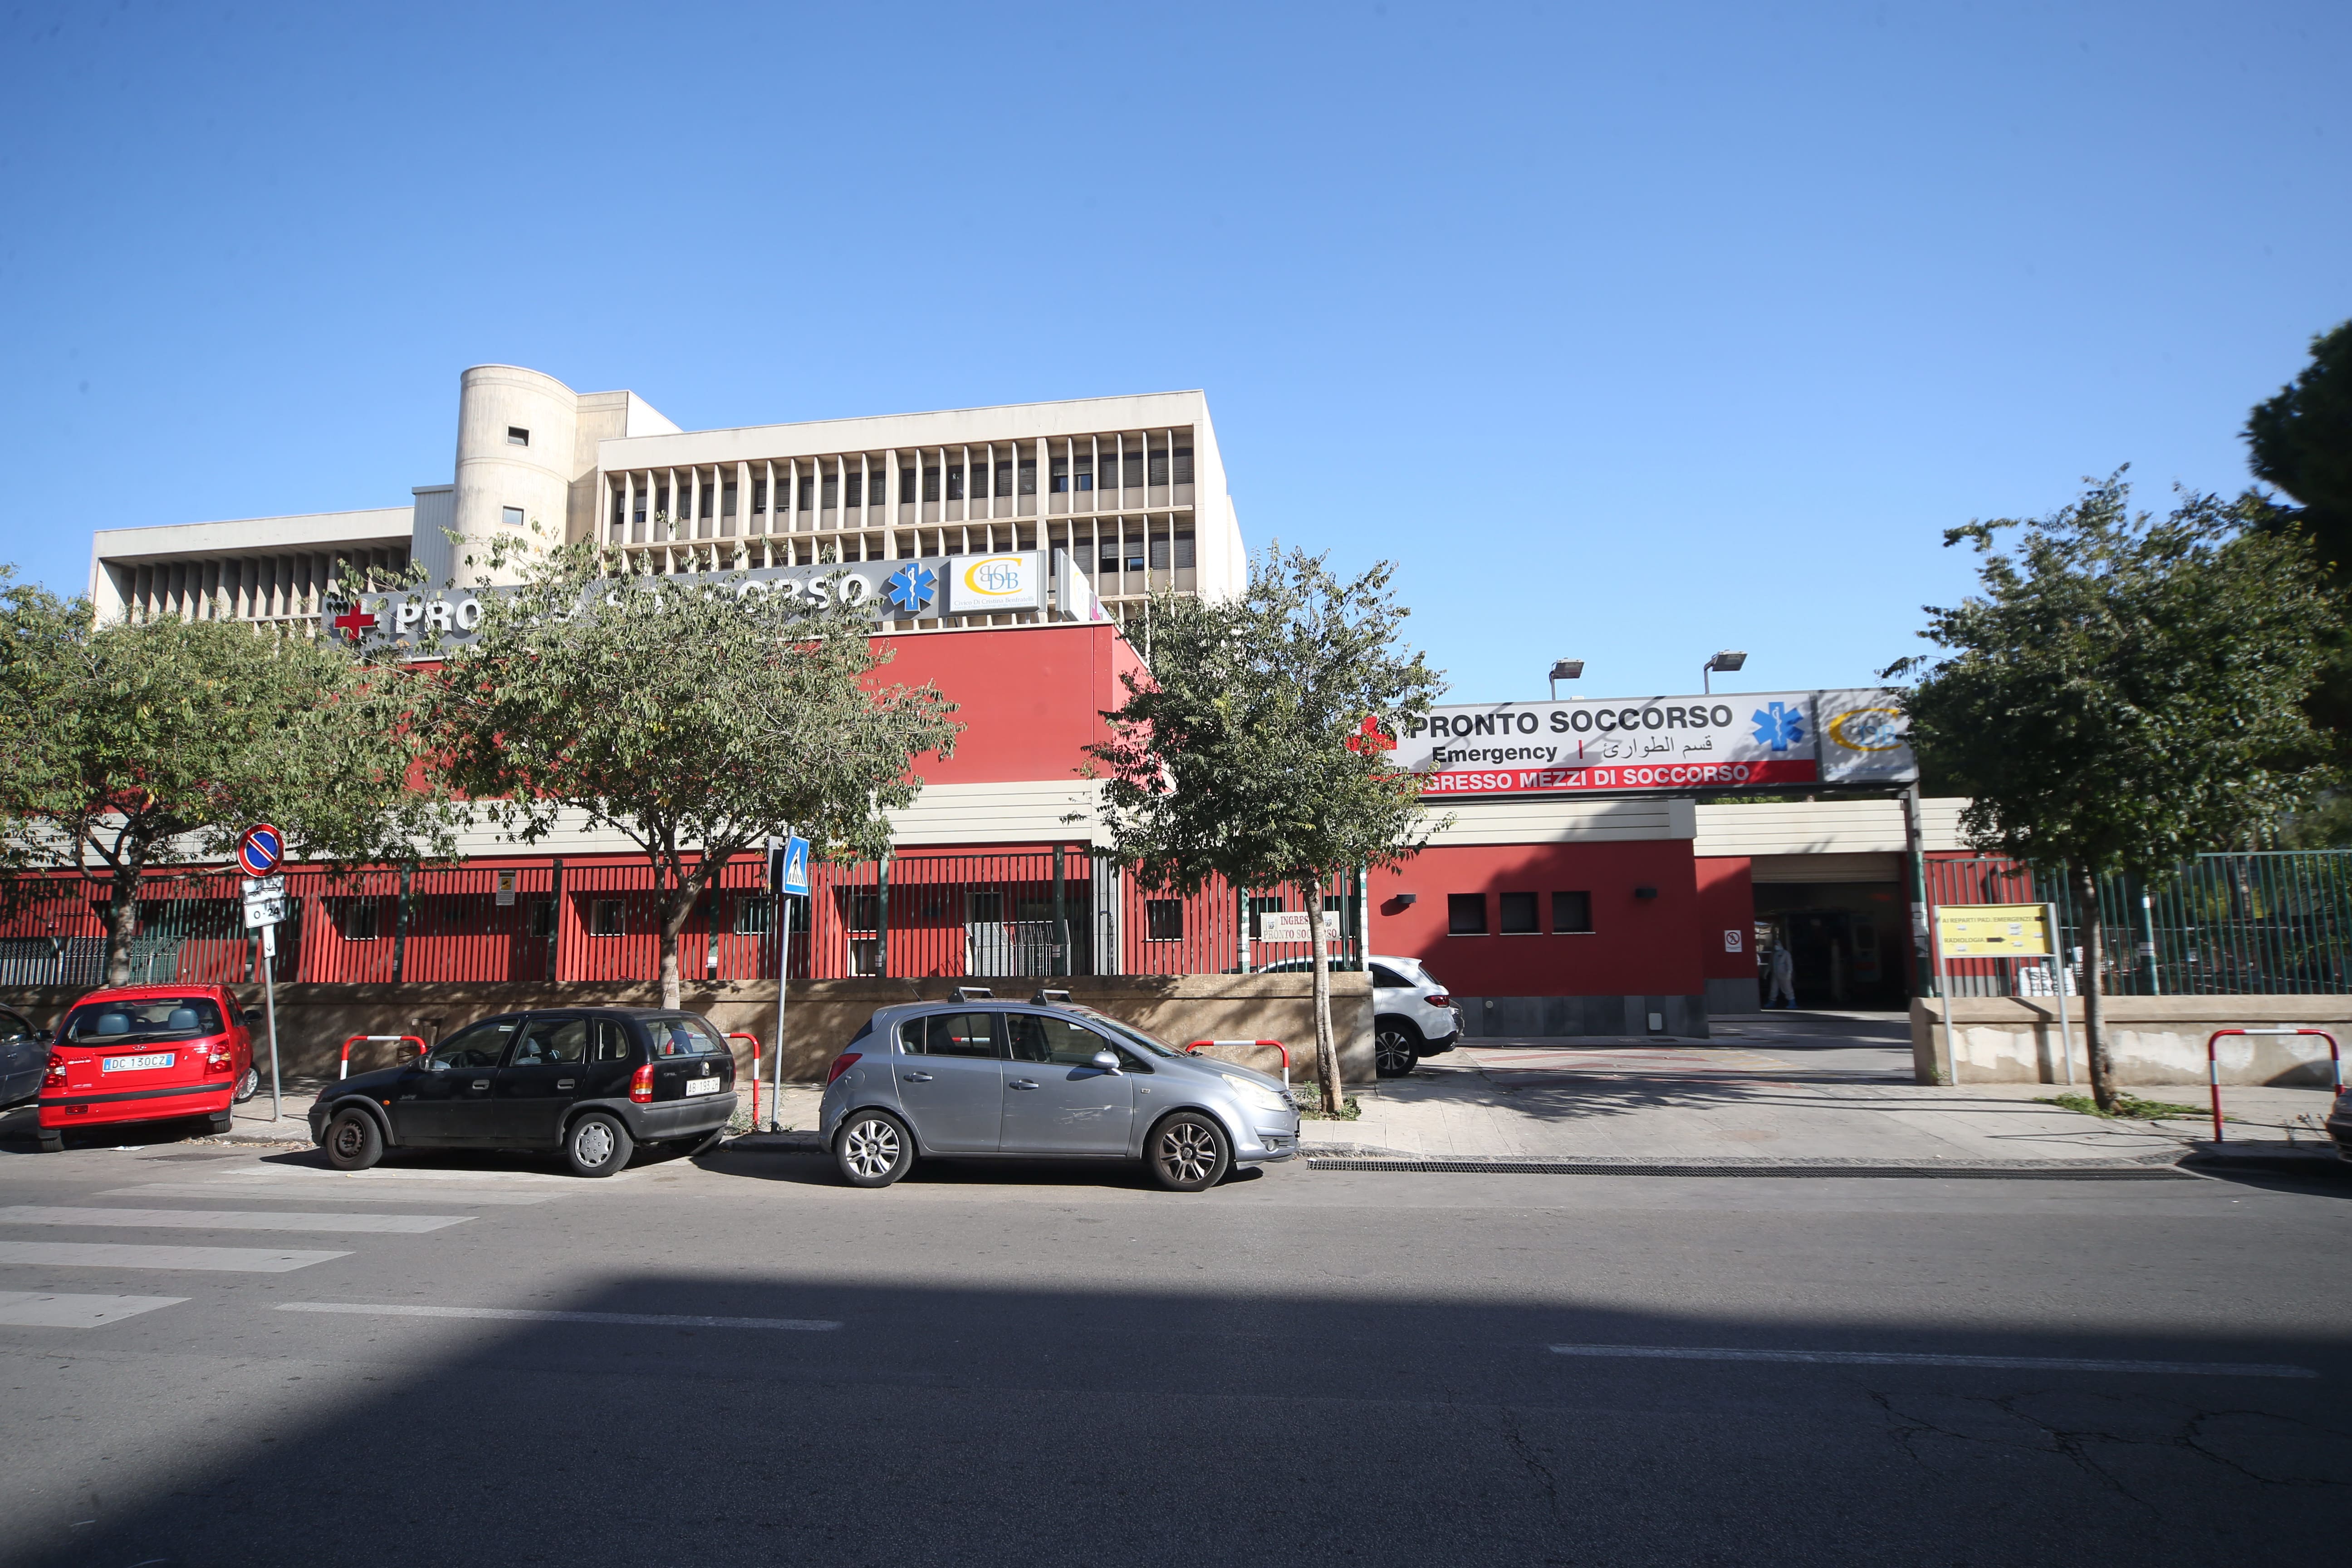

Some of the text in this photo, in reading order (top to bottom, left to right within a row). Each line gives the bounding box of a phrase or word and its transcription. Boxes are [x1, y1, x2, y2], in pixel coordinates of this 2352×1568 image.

[1409, 704, 1733, 739] PRONTO SOCCORSO
[1432, 746, 1558, 764] Emergency
[1603, 735, 1713, 760] قسم الطوارئ
[1422, 764, 1749, 791] GRESSO MEZZI DI SOCCORSO
[267, 906, 280, 916] 24
[1263, 930, 1294, 940] PRONTO
[113, 1059, 126, 1068] DC
[131, 1056, 165, 1067] 130CZ
[688, 1083, 696, 1093] AB
[700, 1080, 710, 1092] 193
